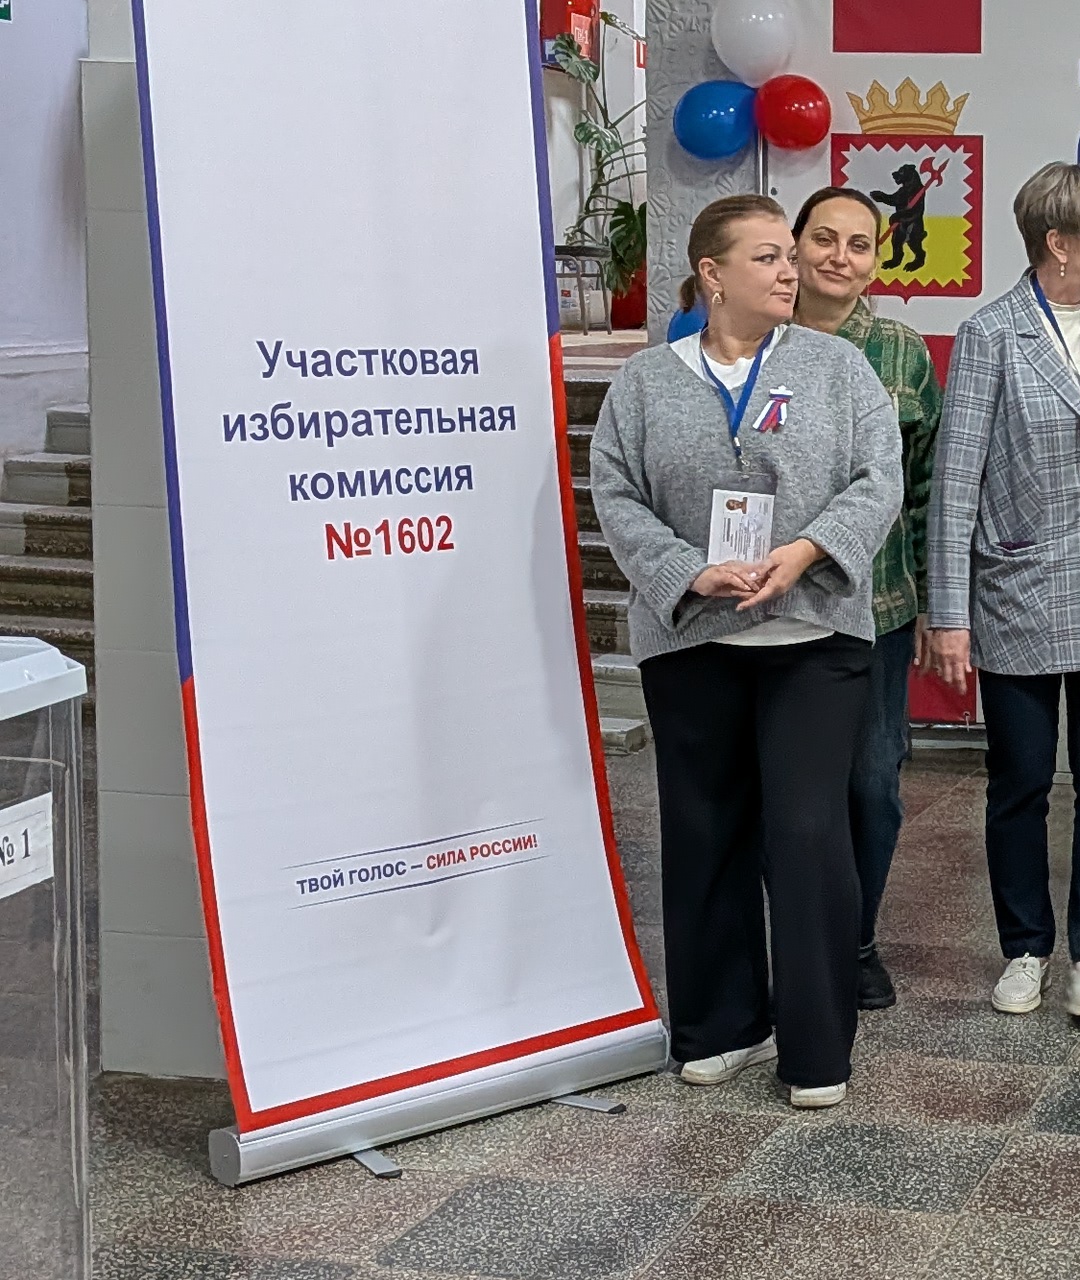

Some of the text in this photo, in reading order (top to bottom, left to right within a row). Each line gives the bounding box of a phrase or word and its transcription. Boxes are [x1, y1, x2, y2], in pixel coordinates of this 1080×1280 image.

[256, 340, 480, 378] Участковая
[222, 402, 517, 447] избирательная
[289, 465, 474, 501] комиссия
[325, 515, 455, 560] №1602
[22, 827, 31, 859] 1
[296, 869, 345, 895] ТВОЙ
[349, 860, 407, 885] ГОЛОС
[426, 848, 467, 870] СИЛА
[469, 834, 538, 861] РОССИИ!
